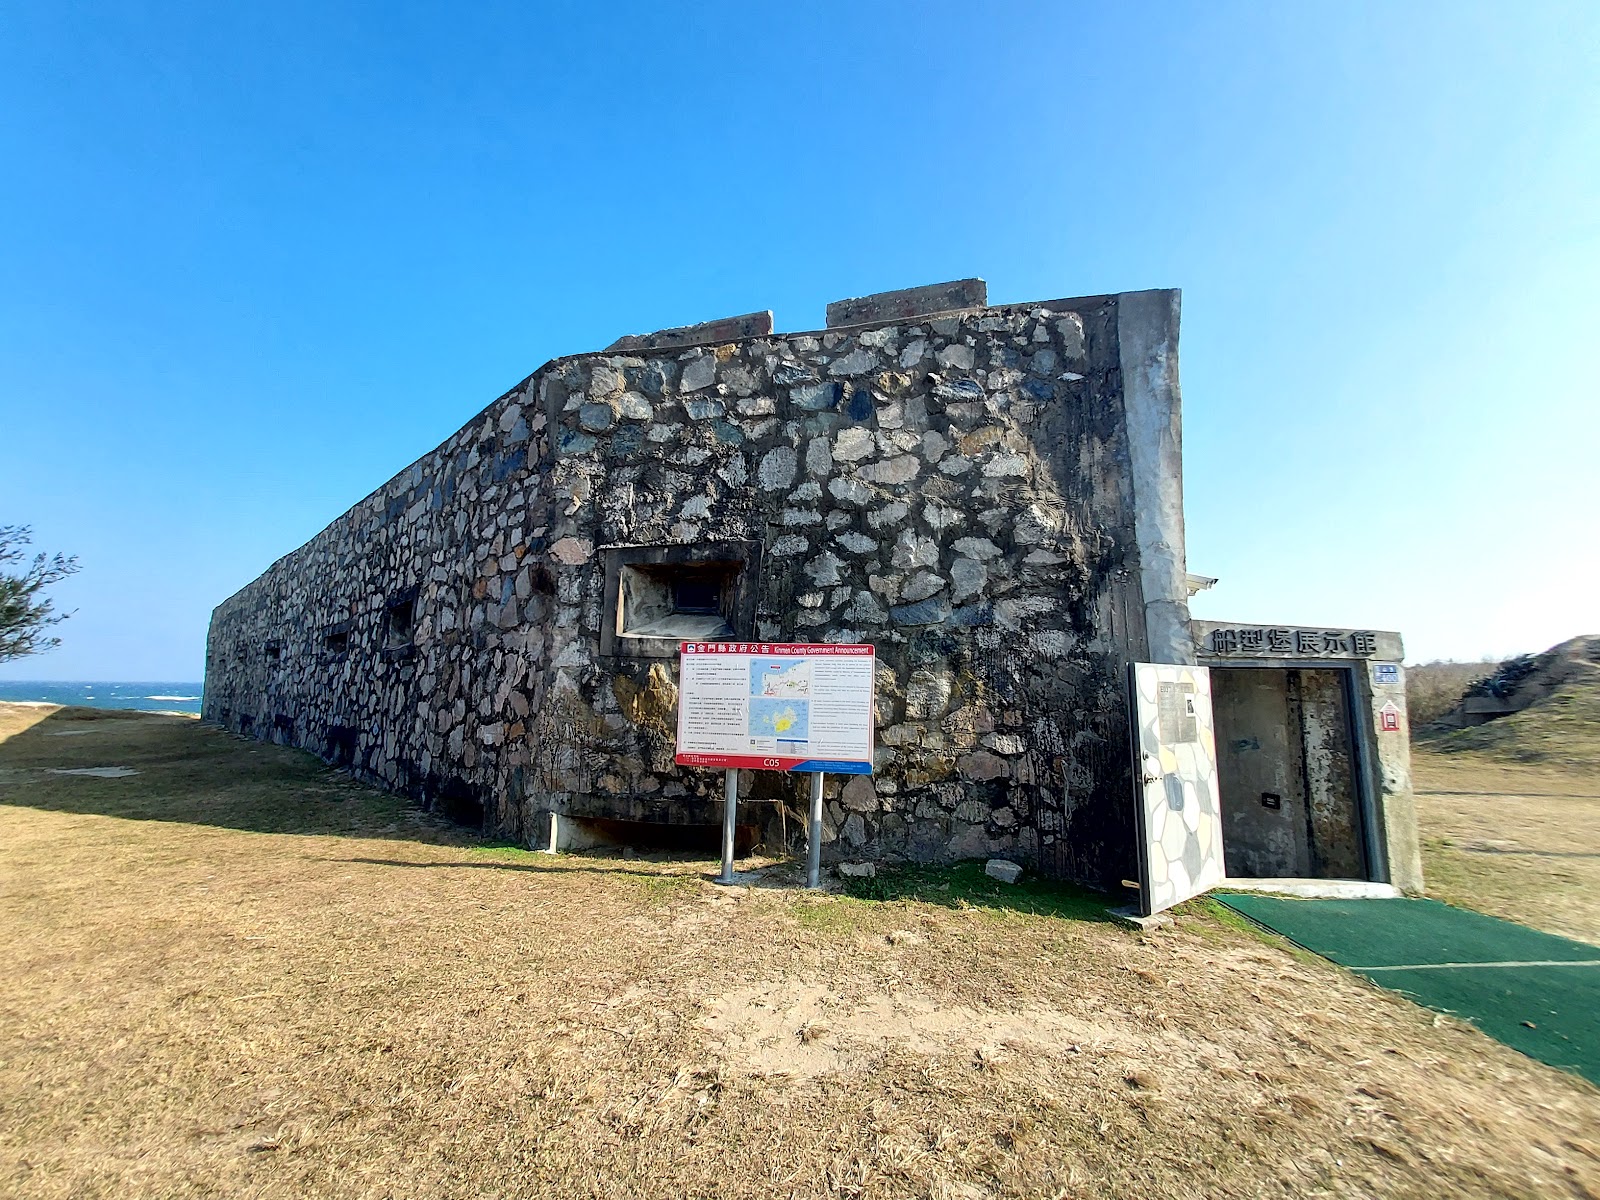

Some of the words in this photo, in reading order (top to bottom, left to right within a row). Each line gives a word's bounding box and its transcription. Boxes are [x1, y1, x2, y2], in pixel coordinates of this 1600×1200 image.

[1212, 628, 1377, 655] 船型堡展示館
[697, 644, 770, 654] 金門縣政府公告
[774, 646, 791, 654] Kinmen
[791, 646, 806, 655] County
[807, 646, 834, 654] Government
[834, 646, 869, 654] Announcement
[763, 758, 780, 767] C05
